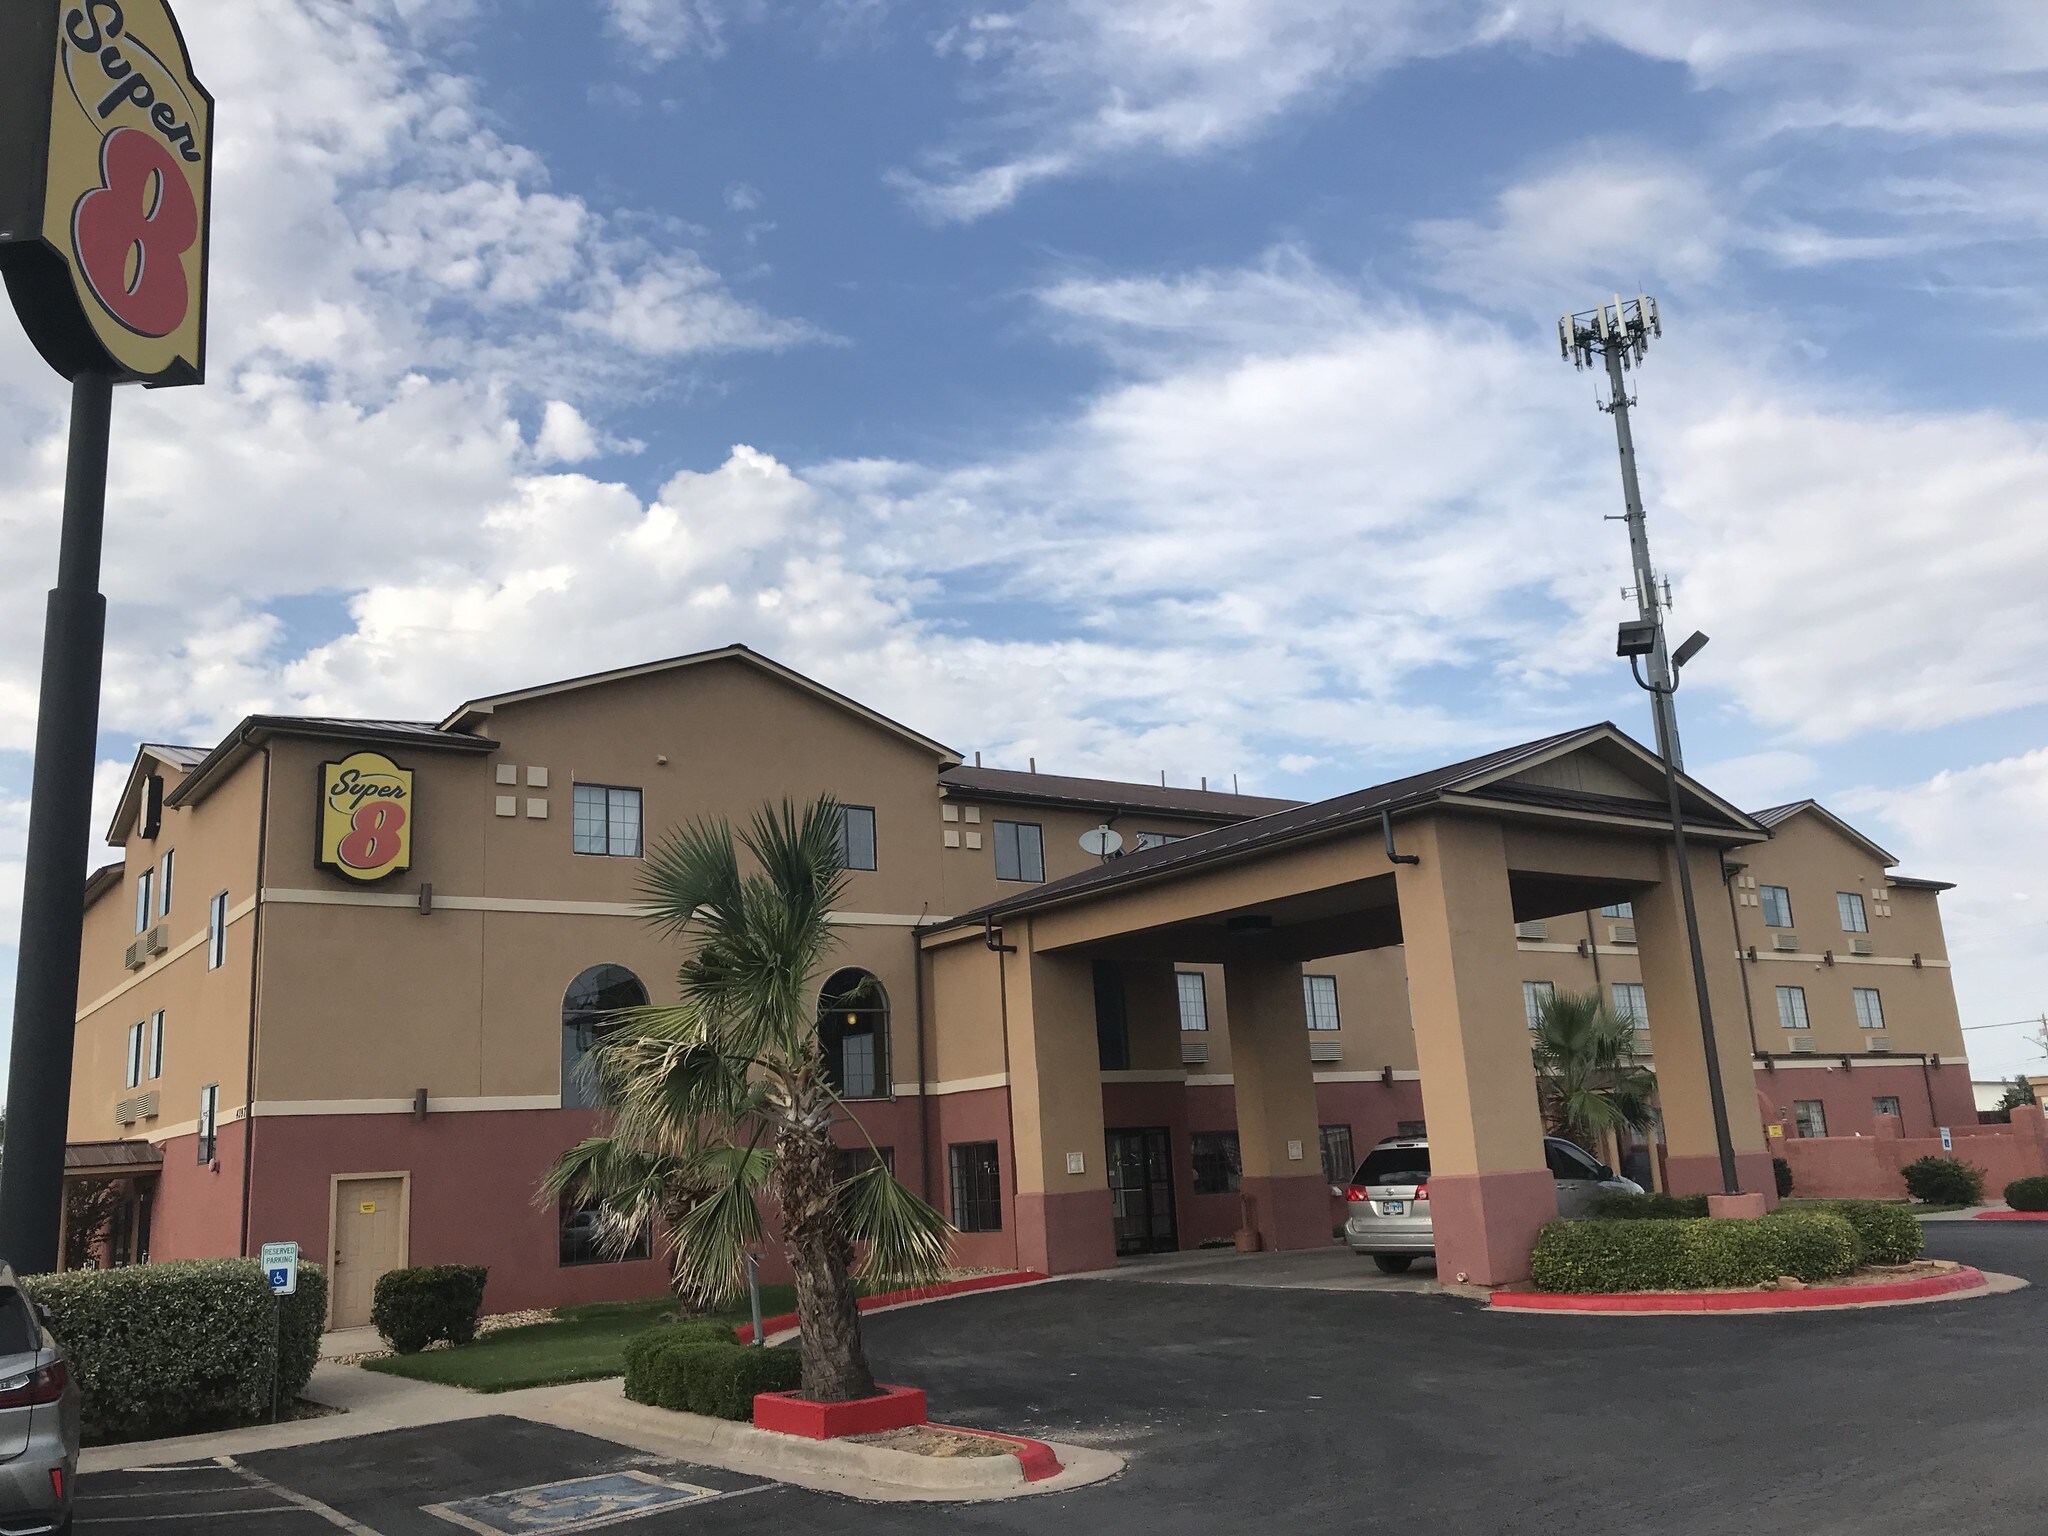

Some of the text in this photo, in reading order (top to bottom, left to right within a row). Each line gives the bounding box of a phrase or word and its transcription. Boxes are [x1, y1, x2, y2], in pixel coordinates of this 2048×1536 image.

[65, 0, 201, 163] Super
[70, 127, 199, 339] 8
[330, 768, 407, 810] Super
[337, 800, 406, 870] 8
[265, 1247, 294, 1255] RESERVED
[266, 1256, 293, 1264] PARKING
